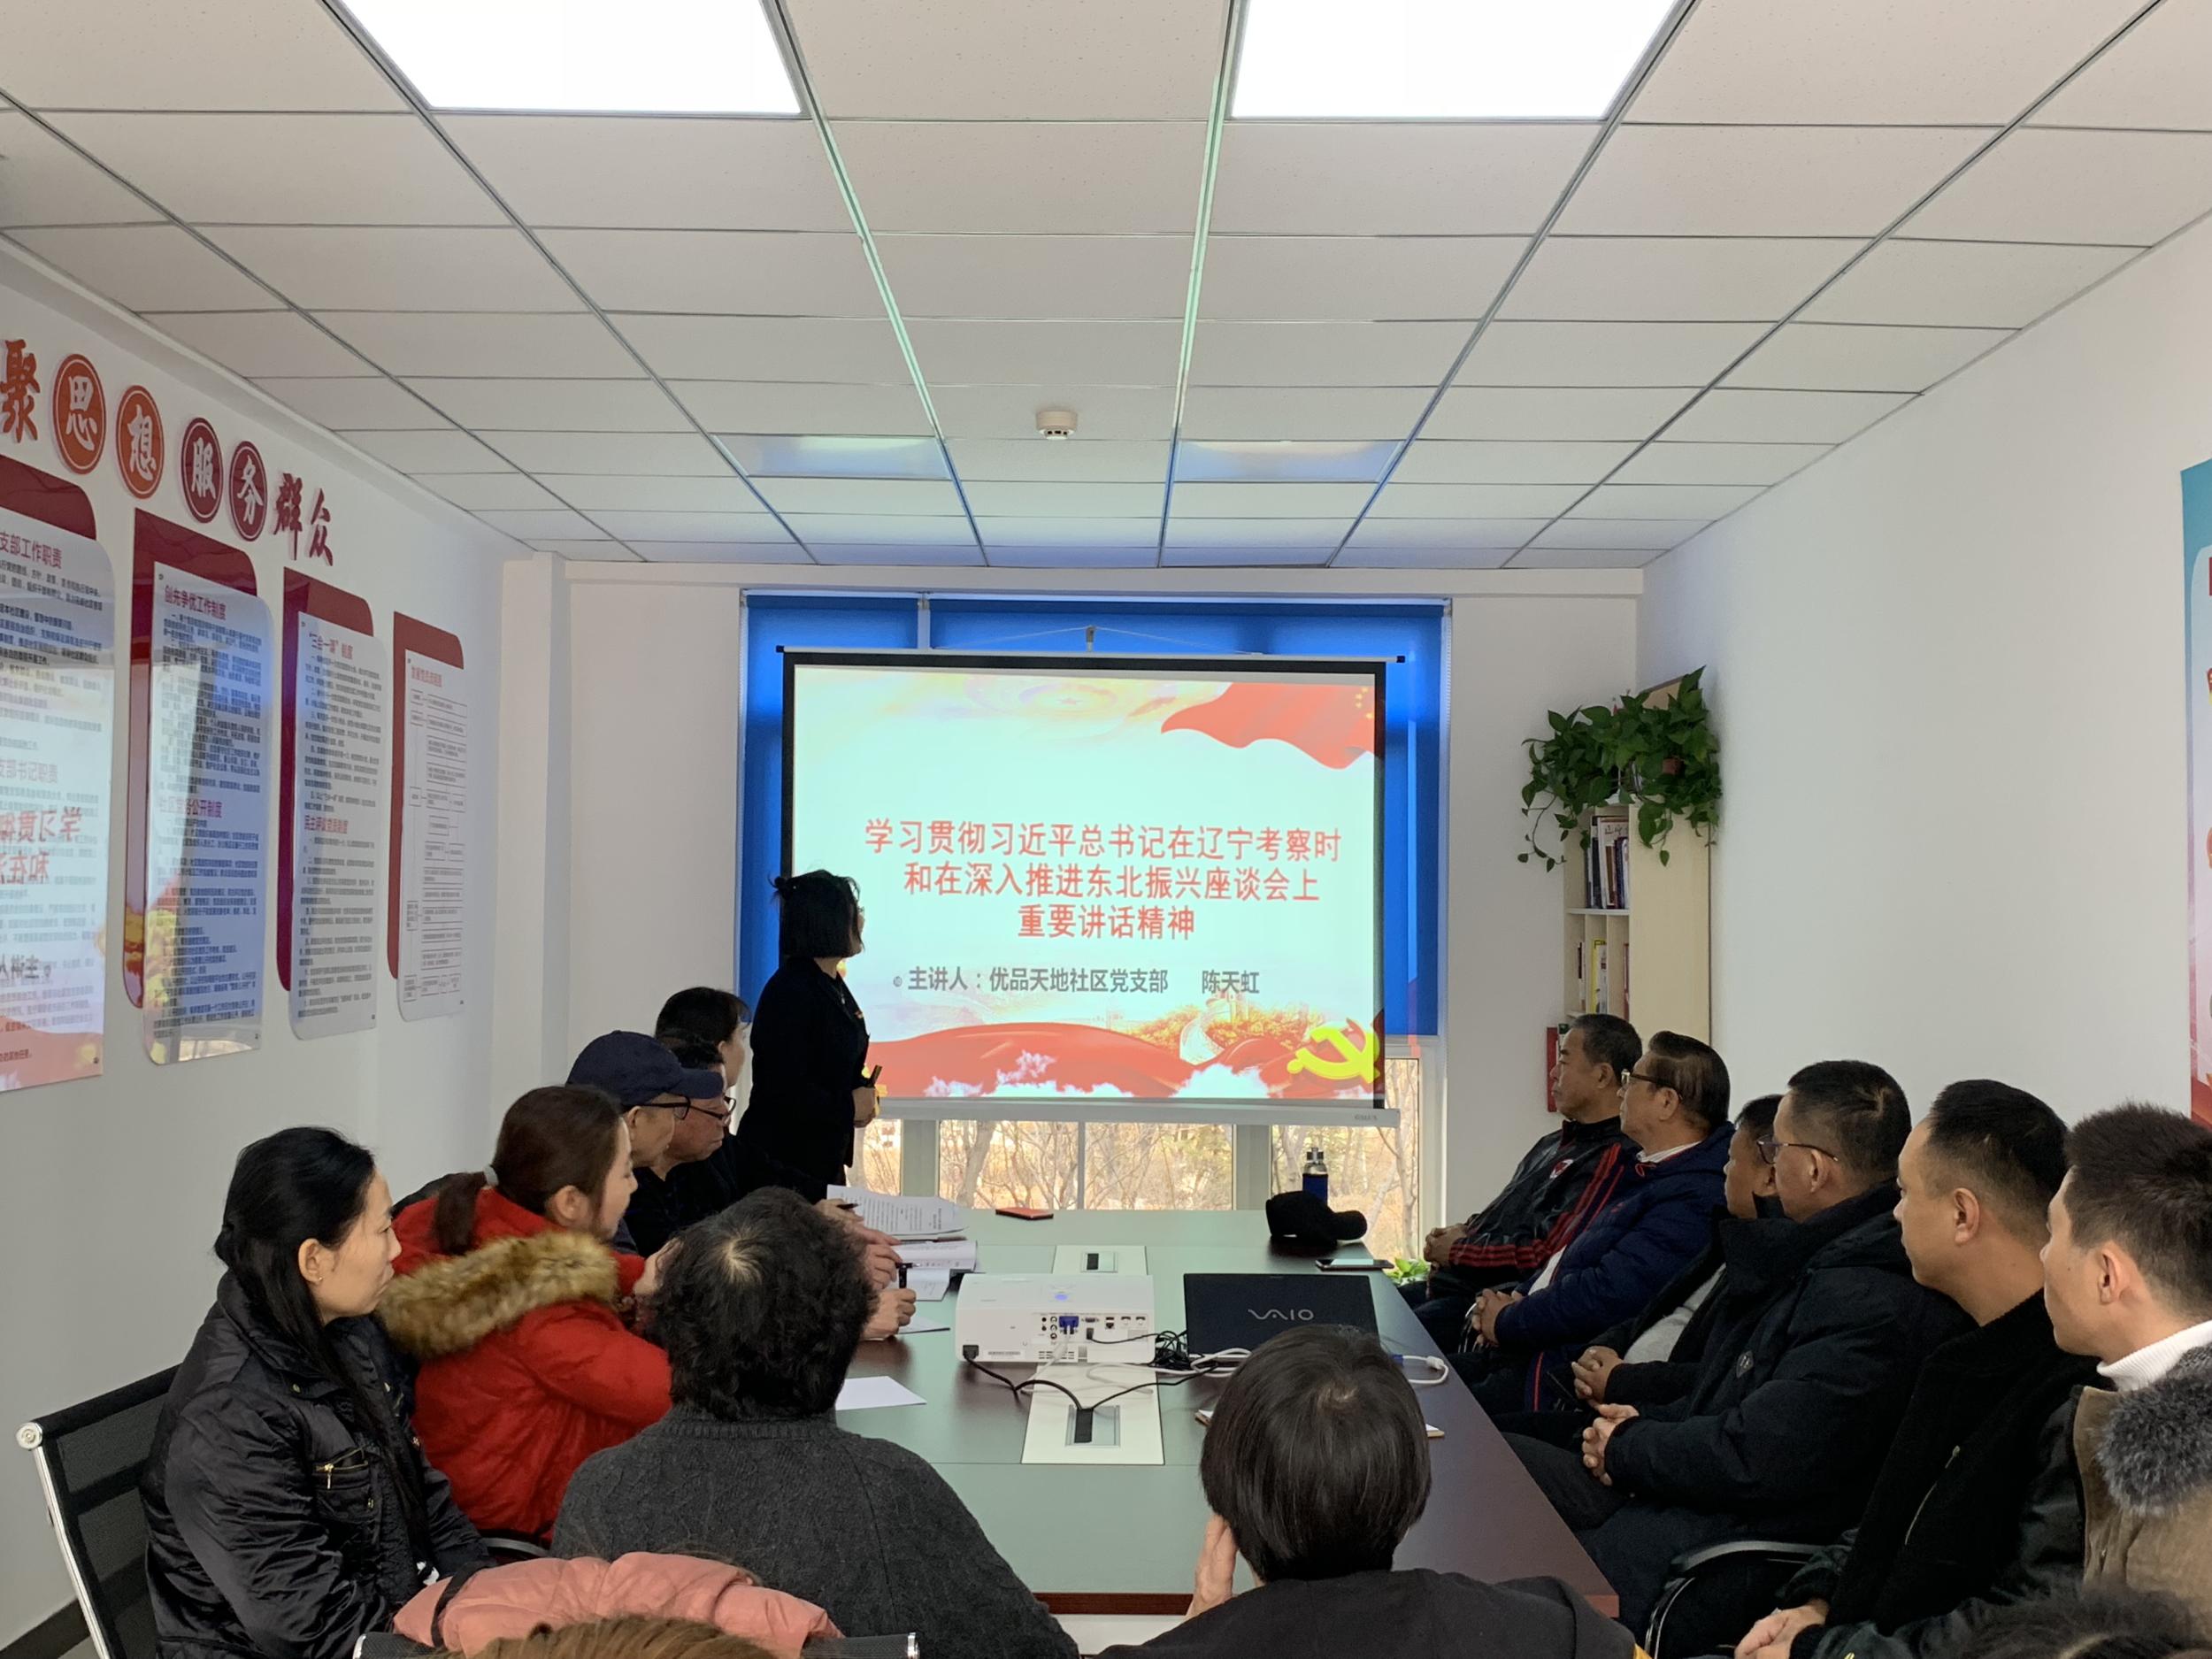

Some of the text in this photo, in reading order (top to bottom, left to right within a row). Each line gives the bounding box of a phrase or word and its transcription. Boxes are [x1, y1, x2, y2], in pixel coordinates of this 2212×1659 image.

[864, 818, 1341, 863] 学习贯彻习近平总书记在辽宁考察时
[903, 860, 1320, 902] 和在深入推进东北振兴座谈会上
[1018, 903, 1194, 940] 重要讲话精神
[1202, 970, 1260, 994] 陈天虹
[1248, 1309, 1314, 1322] VAIO
